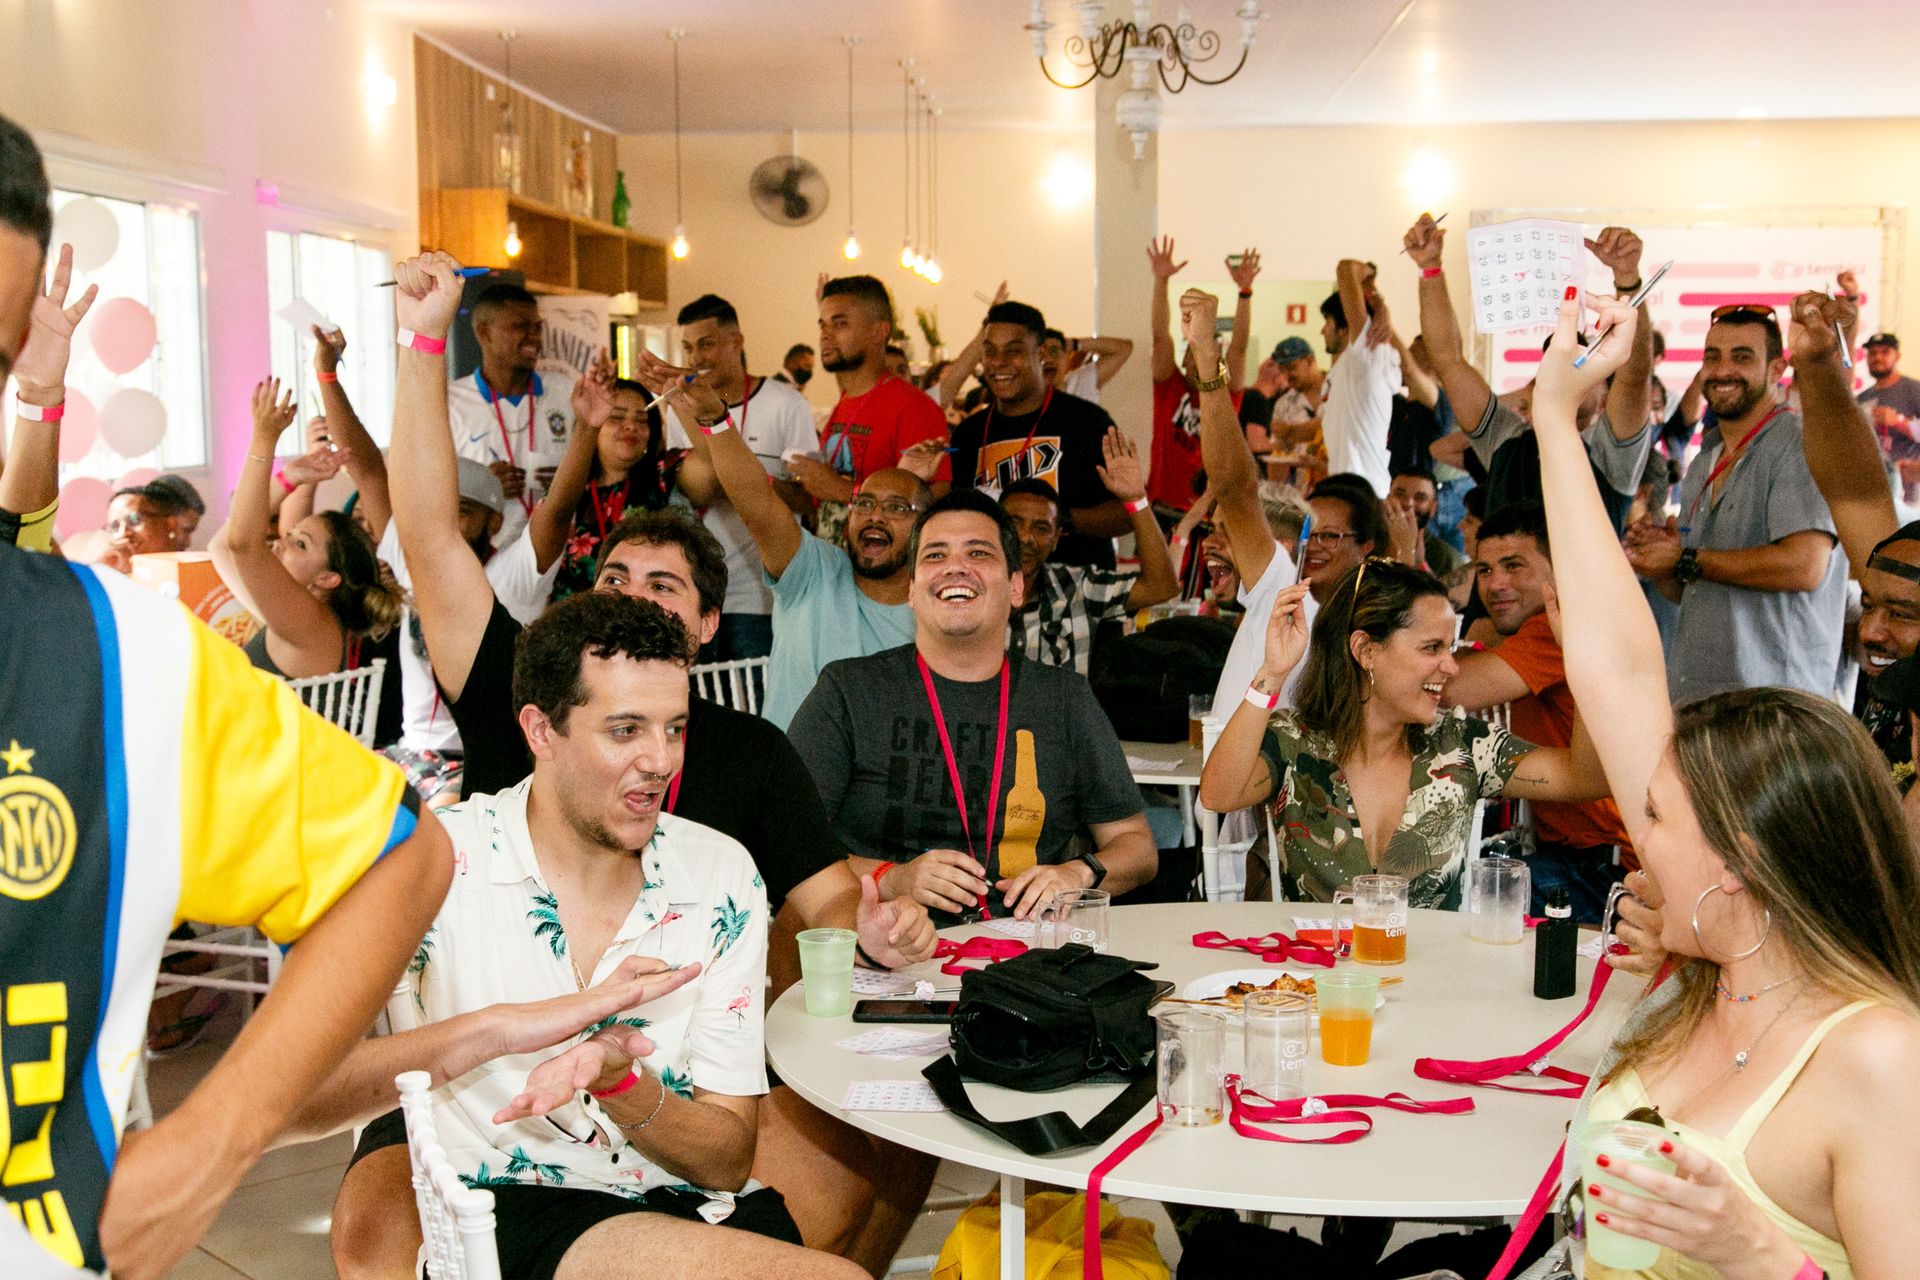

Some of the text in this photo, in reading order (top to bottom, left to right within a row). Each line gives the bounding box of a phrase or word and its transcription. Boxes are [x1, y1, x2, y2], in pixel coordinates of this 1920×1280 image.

[1513, 233, 1521, 243] 10
[1516, 251, 1523, 261] 25
[1500, 273, 1507, 284] 45
[1504, 310, 1512, 321] 68
[1486, 312, 1495, 323] 64
[1522, 308, 1530, 319] 70
